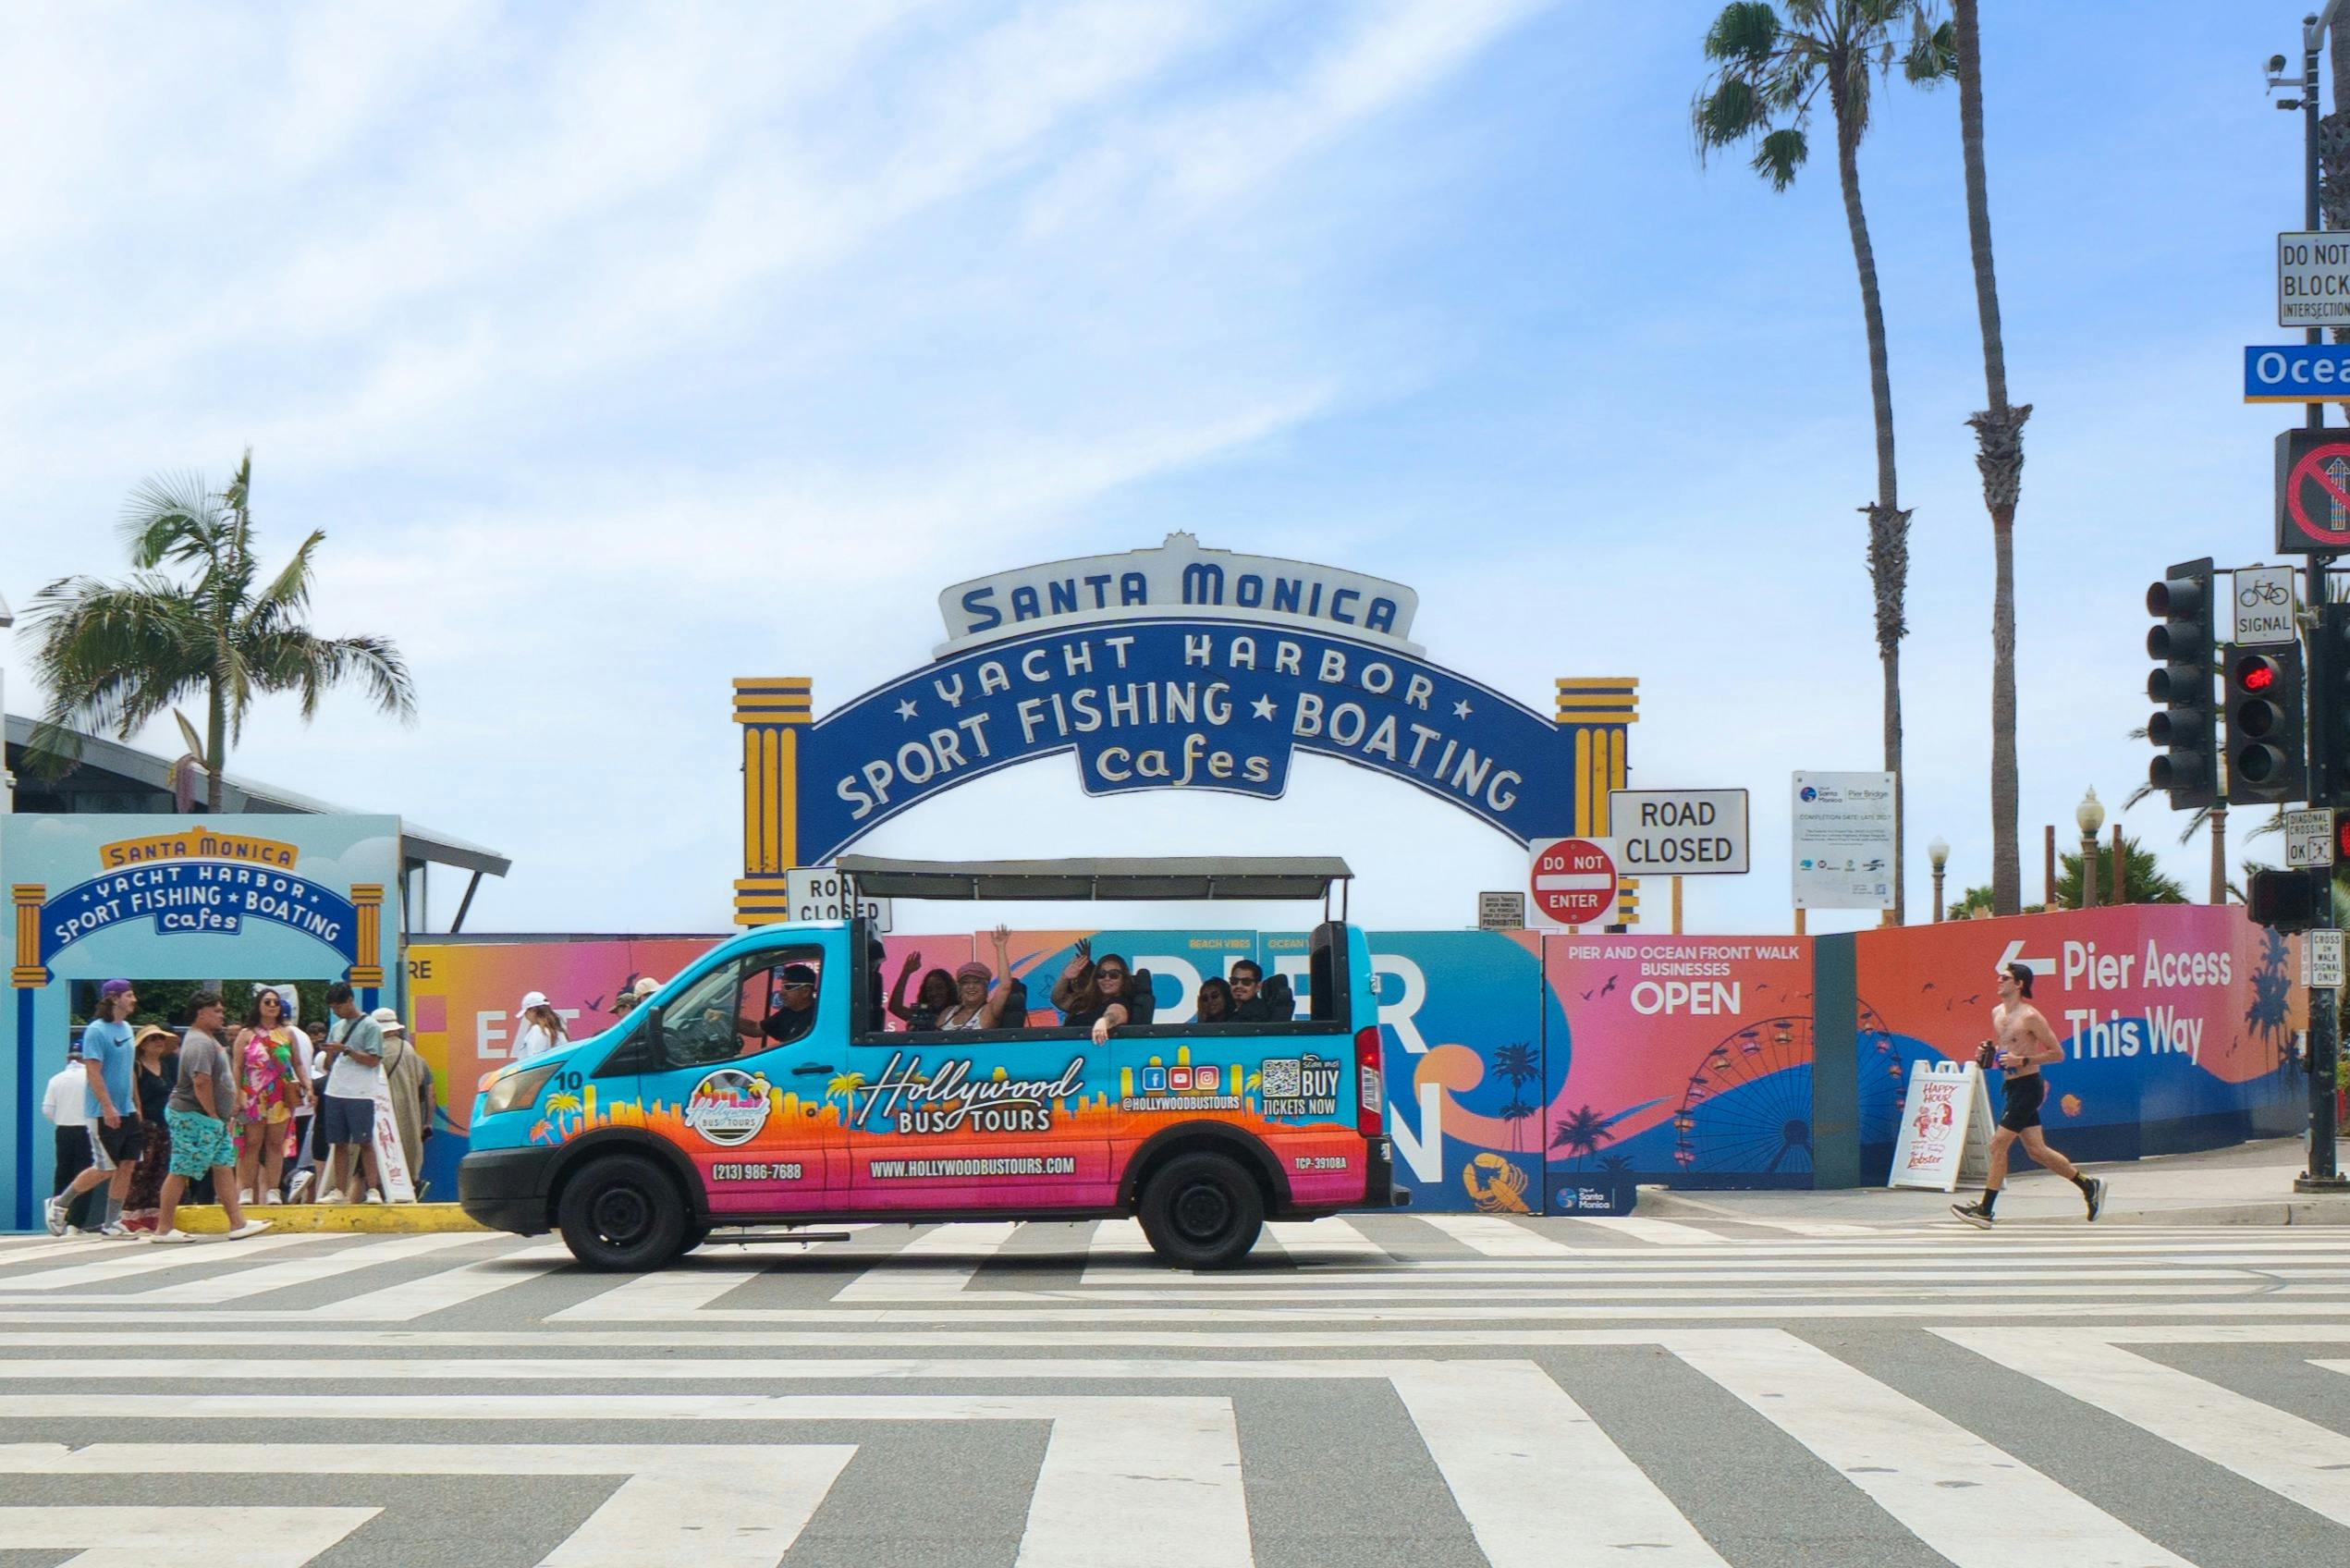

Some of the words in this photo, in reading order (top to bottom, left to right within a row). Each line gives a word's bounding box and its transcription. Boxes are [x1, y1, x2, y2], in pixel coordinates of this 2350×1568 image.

[2283, 245, 2307, 265] DO
[2315, 243, 2350, 265] NOT
[2283, 275, 2350, 297] BLOCK
[2283, 301, 2350, 318] INTERSECTION
[961, 571, 1146, 633] SANTA
[1182, 562, 1397, 634] MONICA
[2239, 615, 2291, 633] SIGNAL
[934, 636, 1134, 707] YACHT
[1184, 634, 1434, 711] HARBOR
[836, 712, 989, 821] SPORT
[1016, 682, 1232, 744] FISHING
[1292, 692, 1522, 813] BOATING
[1641, 802, 1716, 827] ROAD
[2290, 813, 2328, 825] DIAGONAL
[2290, 823, 2329, 835] CROSSING
[109, 840, 185, 865] SANTA
[200, 837, 292, 865] MONICA
[1625, 837, 1732, 864] CLOSED
[2290, 844, 2306, 859] OK
[1543, 856, 1564, 871] DO
[1573, 855, 1604, 870] NOT
[96, 866, 182, 898] YACHT
[199, 866, 306, 899] HARBOR
[811, 879, 861, 898] ROA
[1549, 894, 1597, 909] ENTER
[55, 897, 122, 945] SPORT
[131, 886, 221, 913] FISHING
[246, 892, 341, 943] BOATING
[2314, 935, 2340, 945] CROSS
[1569, 946, 1601, 960] PIER
[1604, 946, 1637, 960] AND
[1641, 946, 1696, 960] OCEAN
[1699, 946, 1751, 960] FRONT
[1755, 946, 1800, 960] WALK
[2318, 953, 2337, 962] WALK
[1641, 962, 1731, 976] BUSINESSES
[2063, 940, 2135, 991] Pier
[2142, 938, 2232, 988] Access
[2314, 962, 2341, 973] SIGNAL
[2318, 973, 2338, 982] ONLY
[1630, 981, 1741, 1015] OPEN
[2064, 1008, 2140, 1060] This
[2144, 1004, 2204, 1066] Way
[555, 1071, 582, 1091] 10
[1302, 1070, 1340, 1096] BUY
[1923, 1082, 1959, 1095] HAPPY
[857, 1051, 1085, 1130] Hollywood
[1923, 1094, 1952, 1104] HOUR
[1122, 1096, 1241, 1111] @HOLLYWOODBUSTOURS
[1263, 1098, 1305, 1115] TICKETS
[1308, 1098, 1336, 1115] NOW
[703, 1118, 719, 1127] BUS
[727, 1118, 756, 1127] TOURS
[900, 1110, 946, 1133] BUS
[970, 1109, 1050, 1133] TOURS
[713, 1163, 743, 1182] (213)
[744, 1162, 802, 1181] 986-7688
[870, 1157, 1075, 1179] WWW.HOLLYWOODBUSTOURS.COM
[1578, 1192, 1605, 1201] Santa
[1578, 1201, 1610, 1209] Monica
